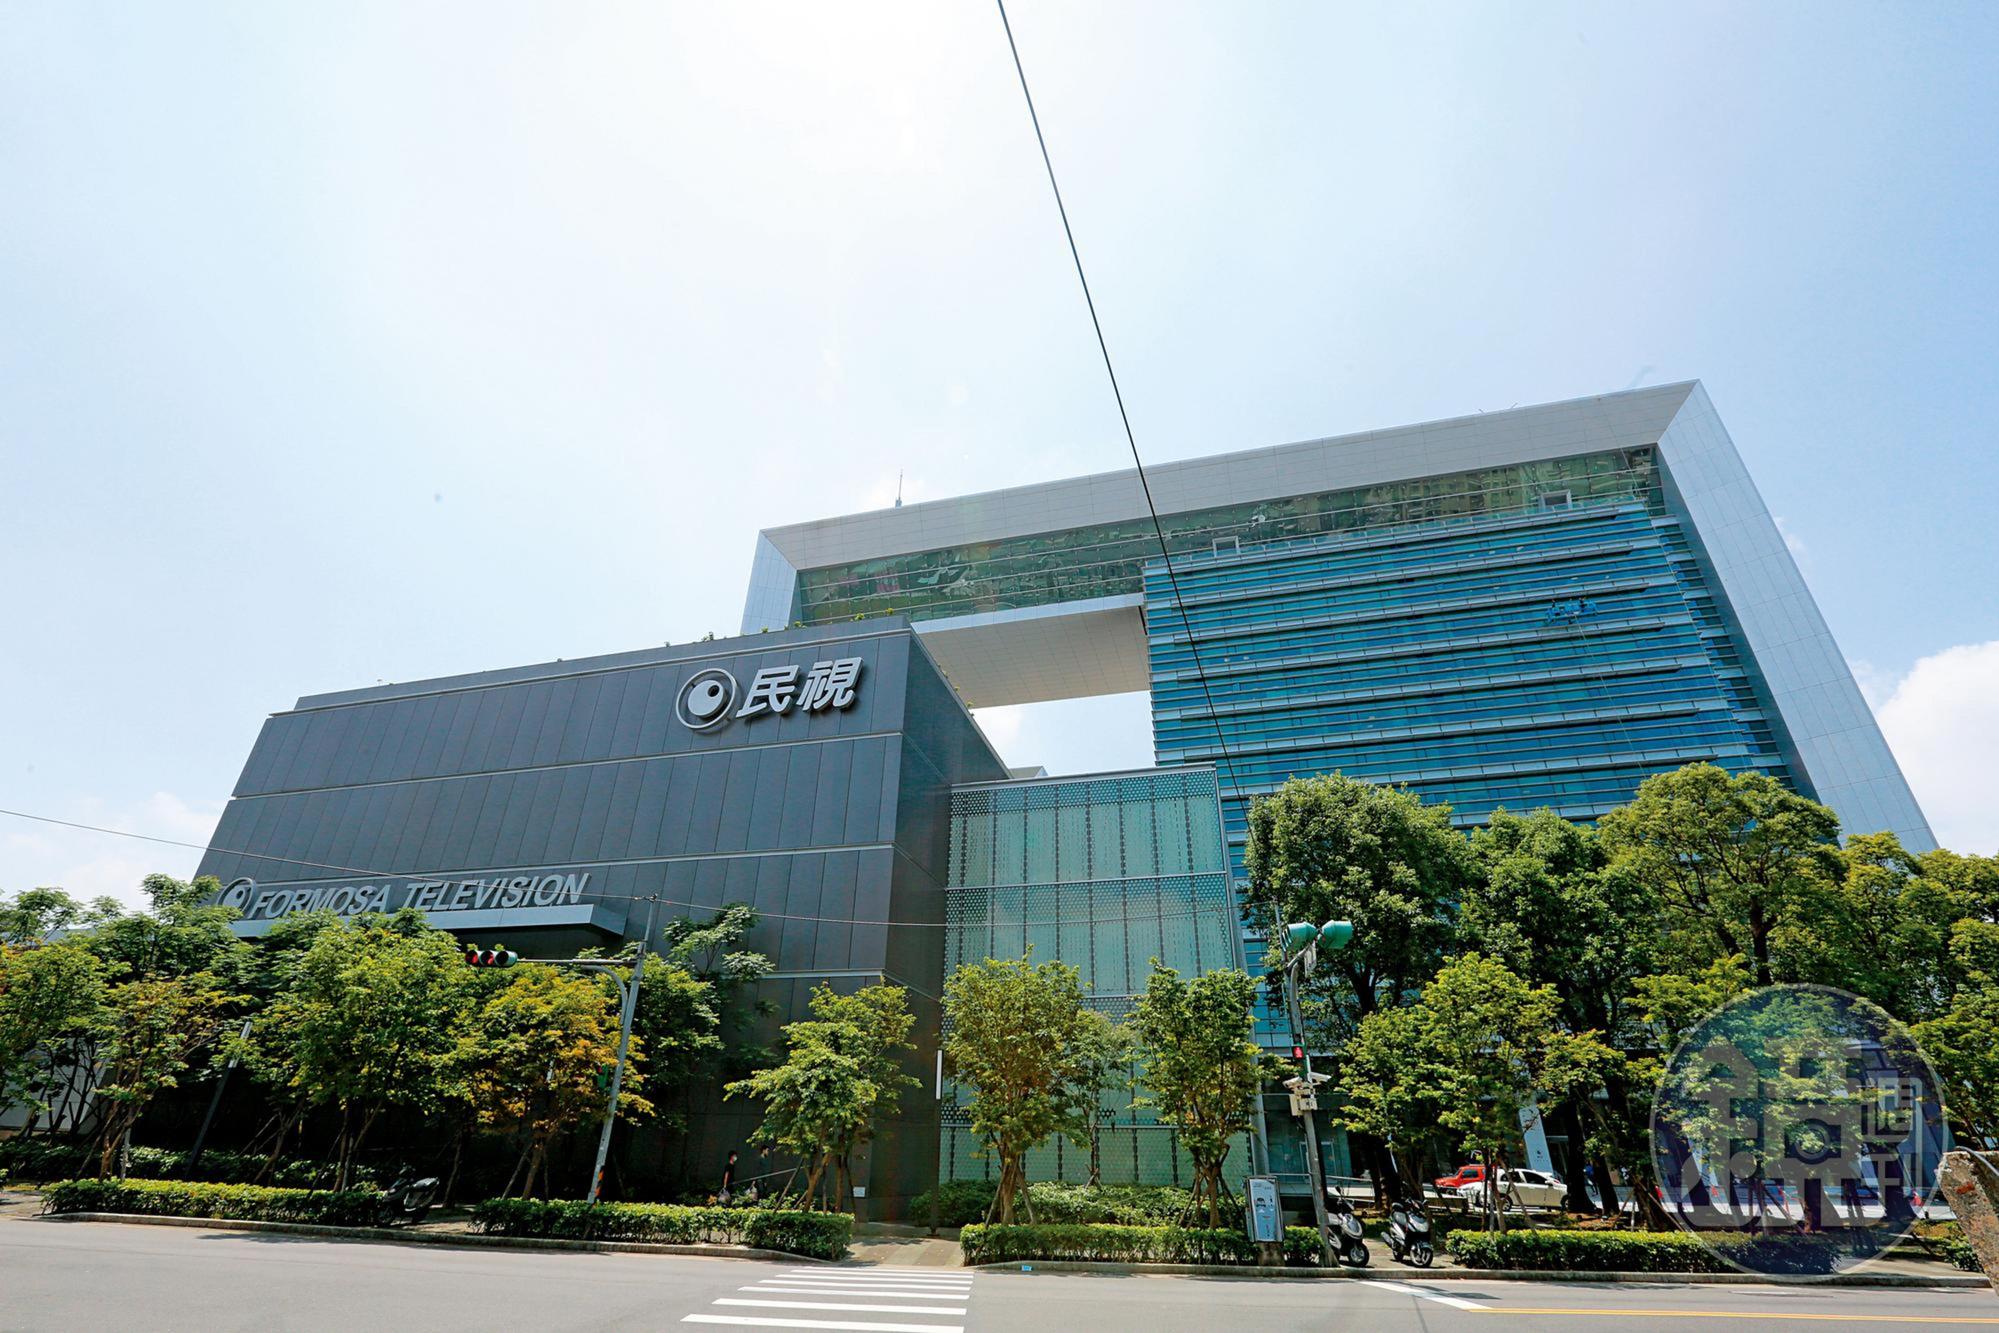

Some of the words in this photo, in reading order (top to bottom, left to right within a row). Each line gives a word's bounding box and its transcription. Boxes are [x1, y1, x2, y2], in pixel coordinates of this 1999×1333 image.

[735, 656, 864, 718] 民視
[248, 884, 391, 920] FORMOSA
[400, 873, 590, 912] TELEVISION
